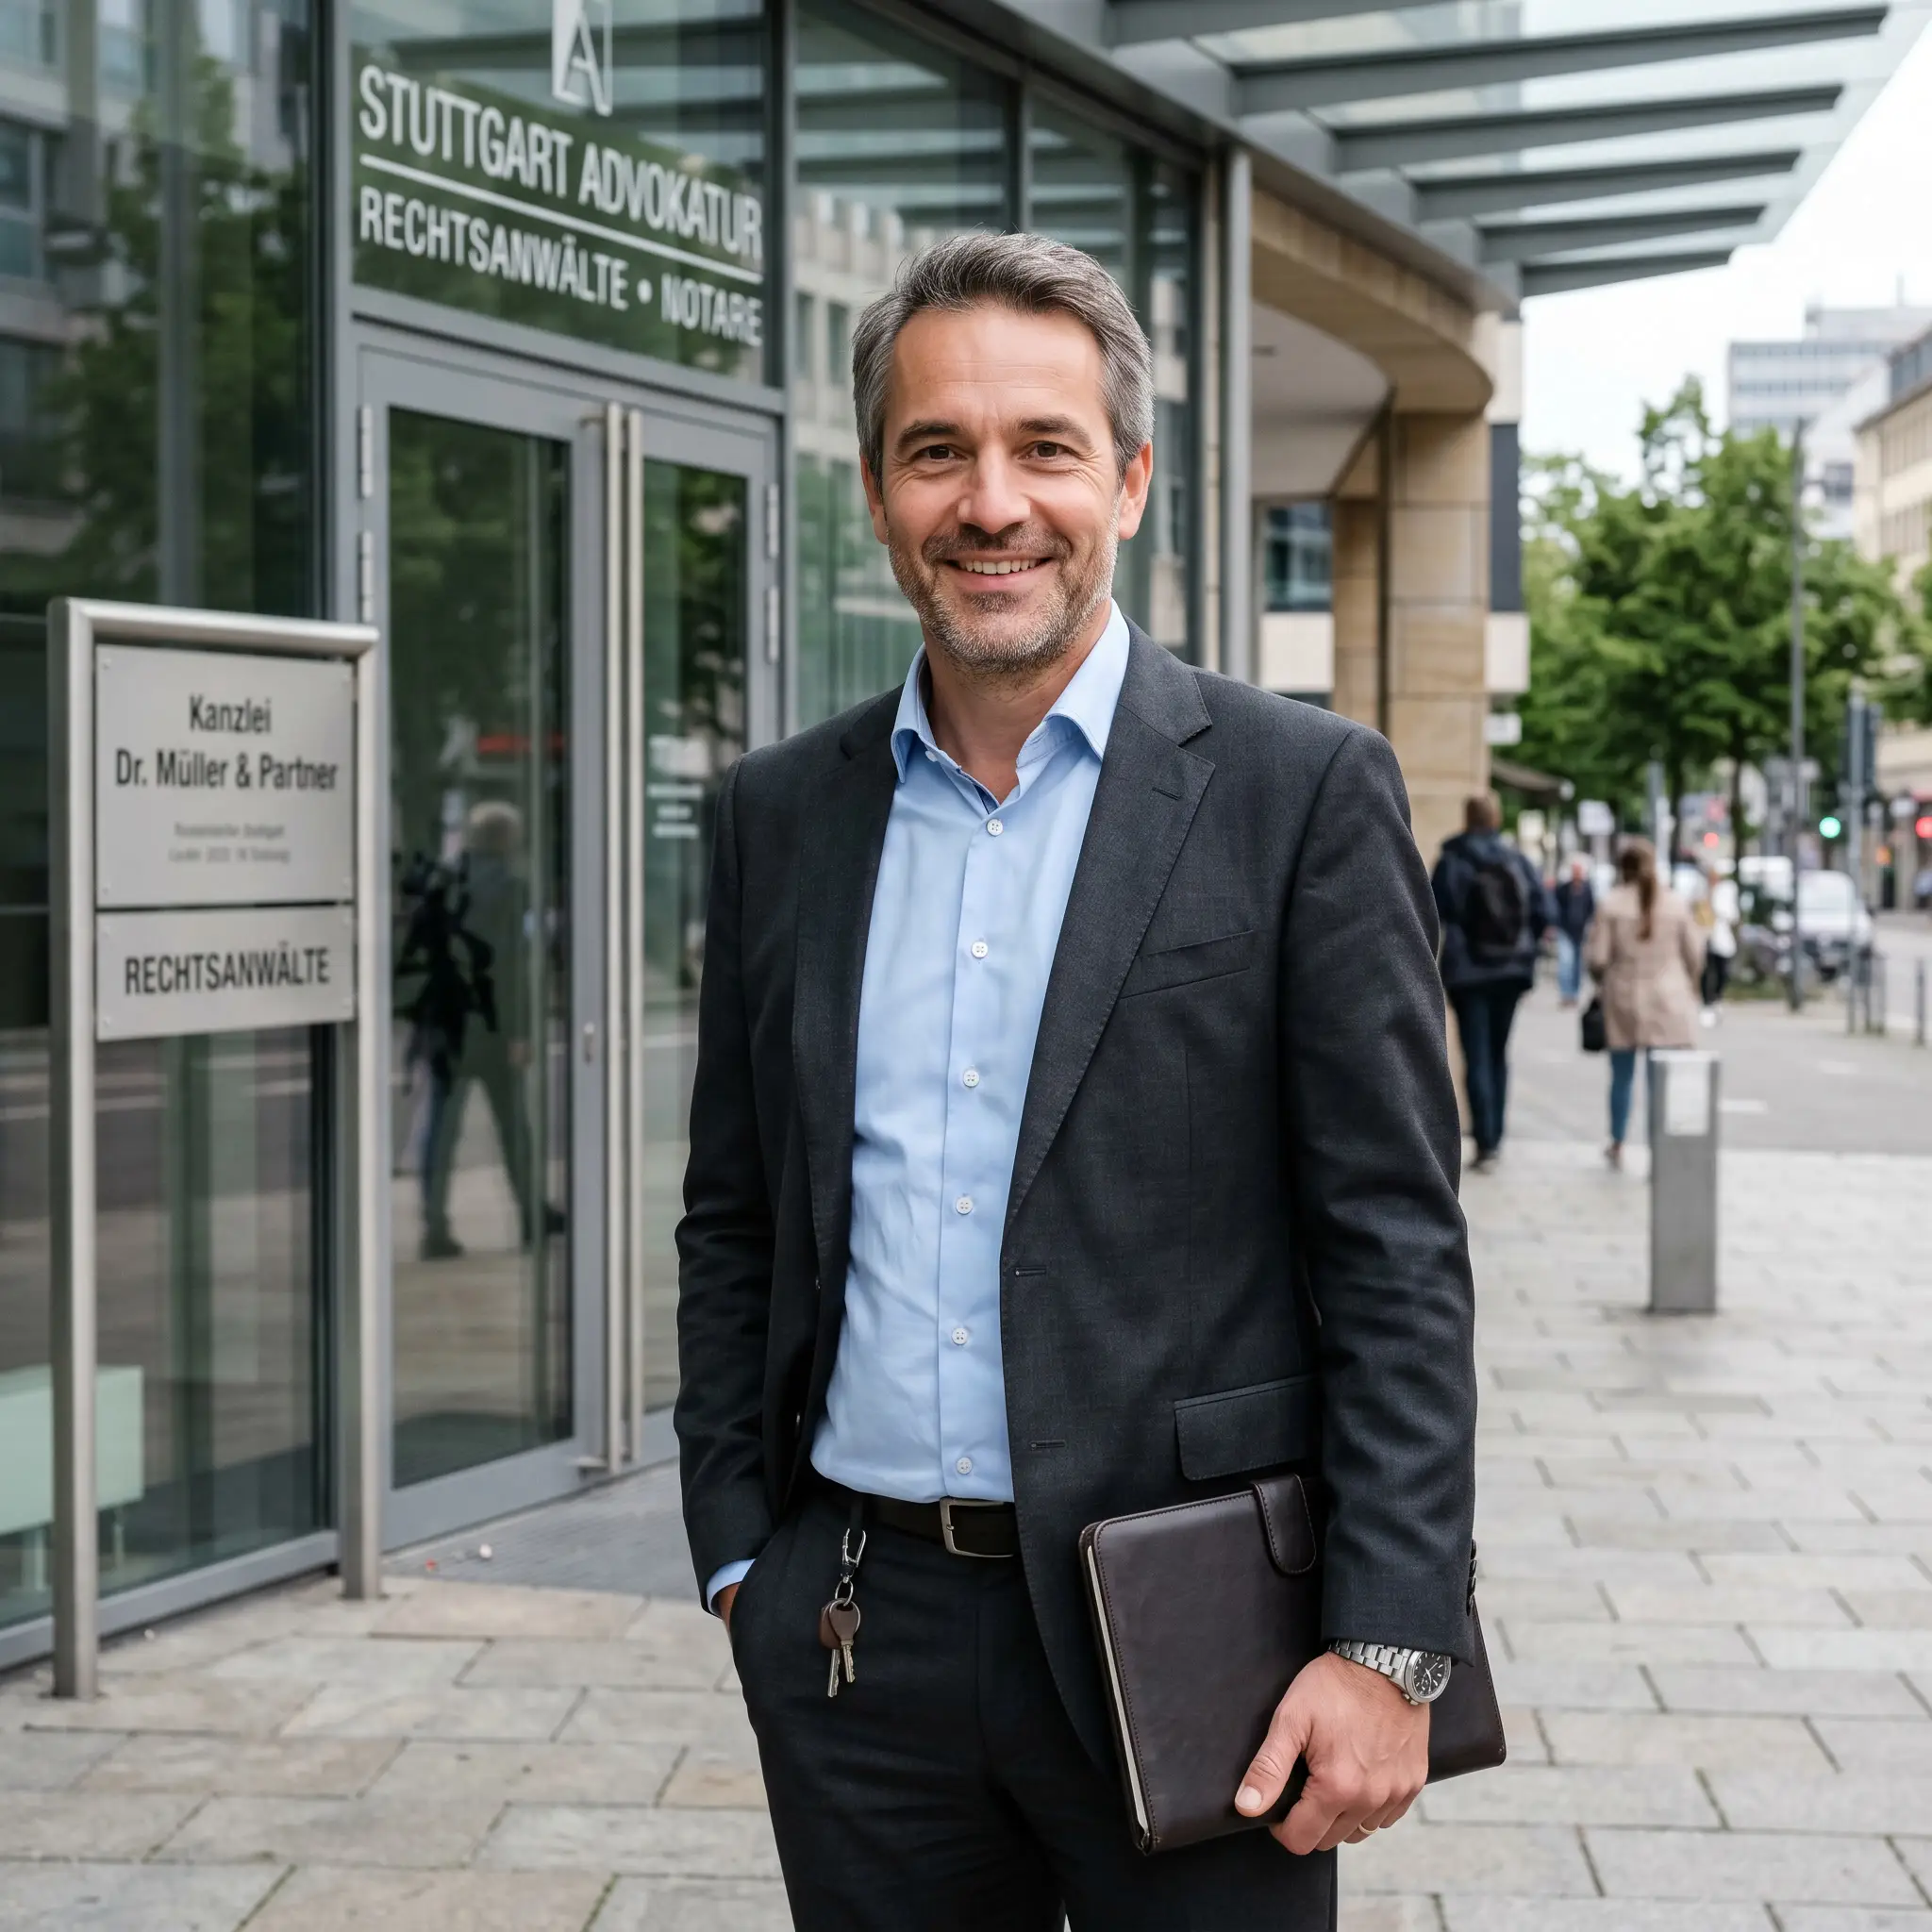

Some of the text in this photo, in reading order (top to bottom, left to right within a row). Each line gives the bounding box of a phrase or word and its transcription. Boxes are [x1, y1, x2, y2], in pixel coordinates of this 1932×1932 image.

[359, 64, 762, 260] STUTTGART ADVOKATUR
[360, 185, 762, 347] RECHTSANWÄLTE NOTARE
[189, 693, 272, 734] Kanzlei
[115, 747, 339, 791] Dr. Müller & Partner
[125, 941, 331, 996] RECHTSANWÄLTE
